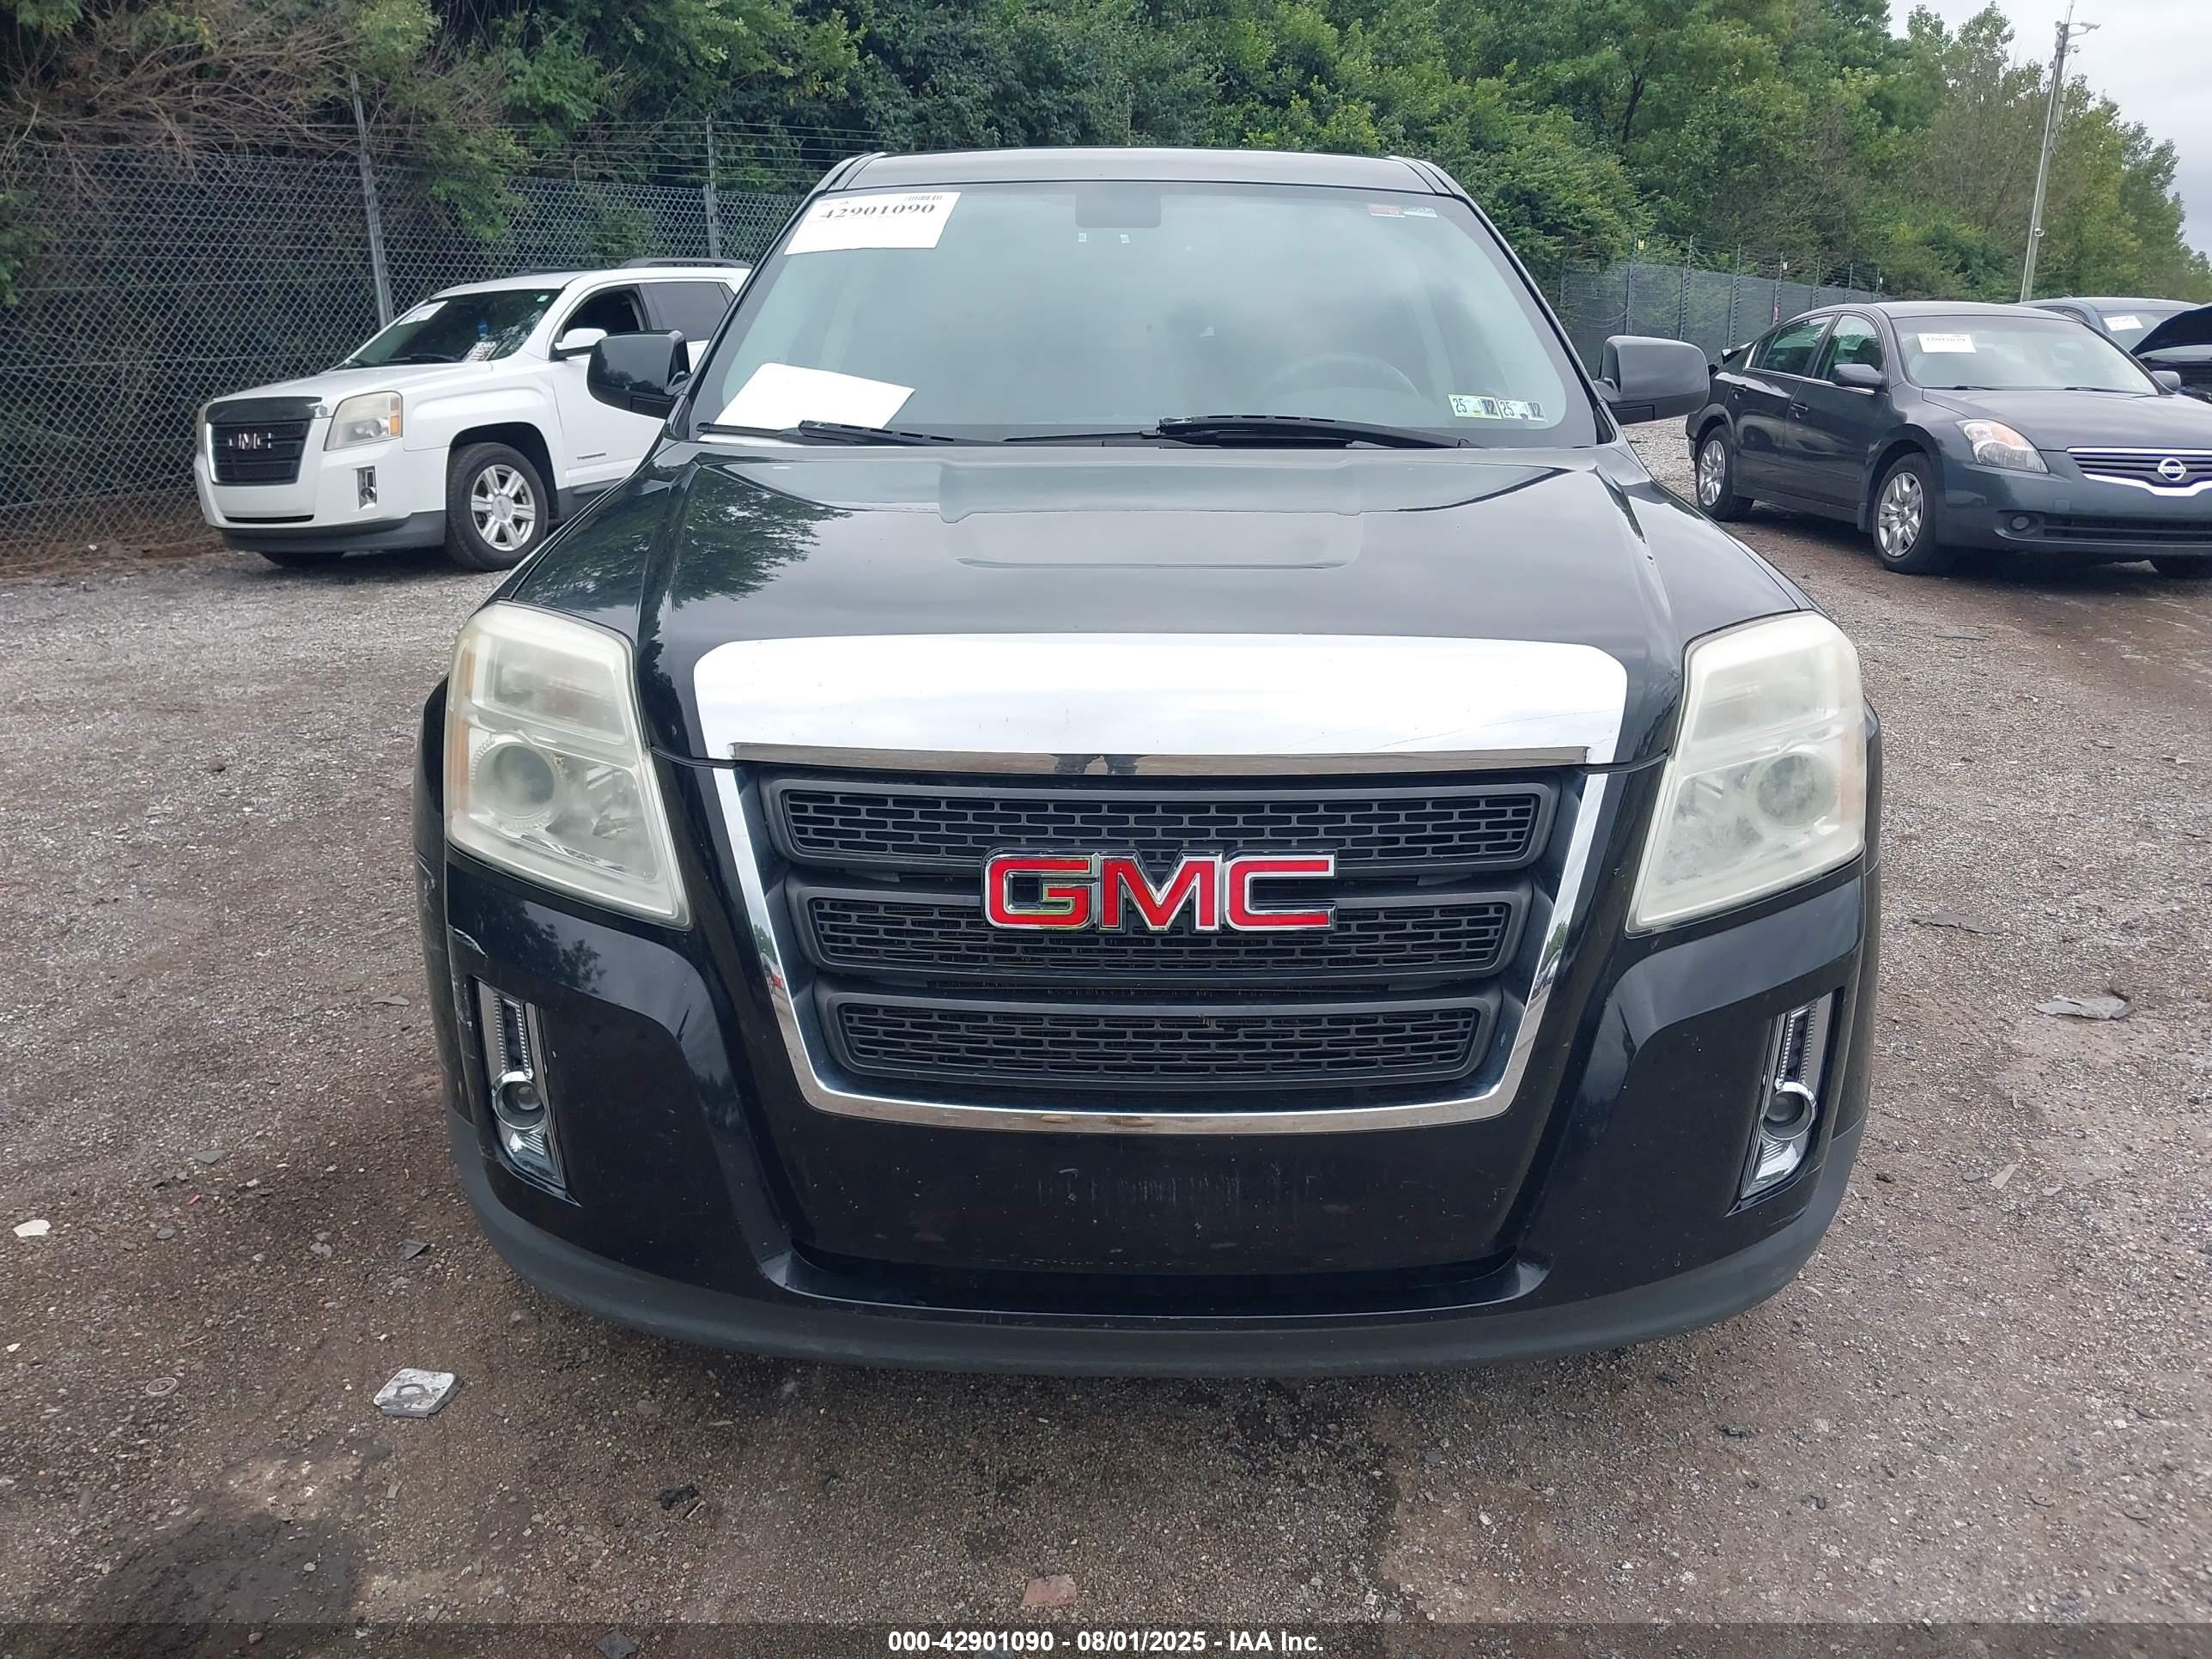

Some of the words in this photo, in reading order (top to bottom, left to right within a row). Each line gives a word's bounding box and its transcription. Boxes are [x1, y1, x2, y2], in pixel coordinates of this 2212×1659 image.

[820, 204, 935, 219] 42901090
[1452, 398, 1468, 413] 25
[1481, 398, 1498, 415] 12
[1500, 401, 1515, 416] 25
[1528, 402, 1545, 417] 12
[984, 852, 1336, 933] GMC
